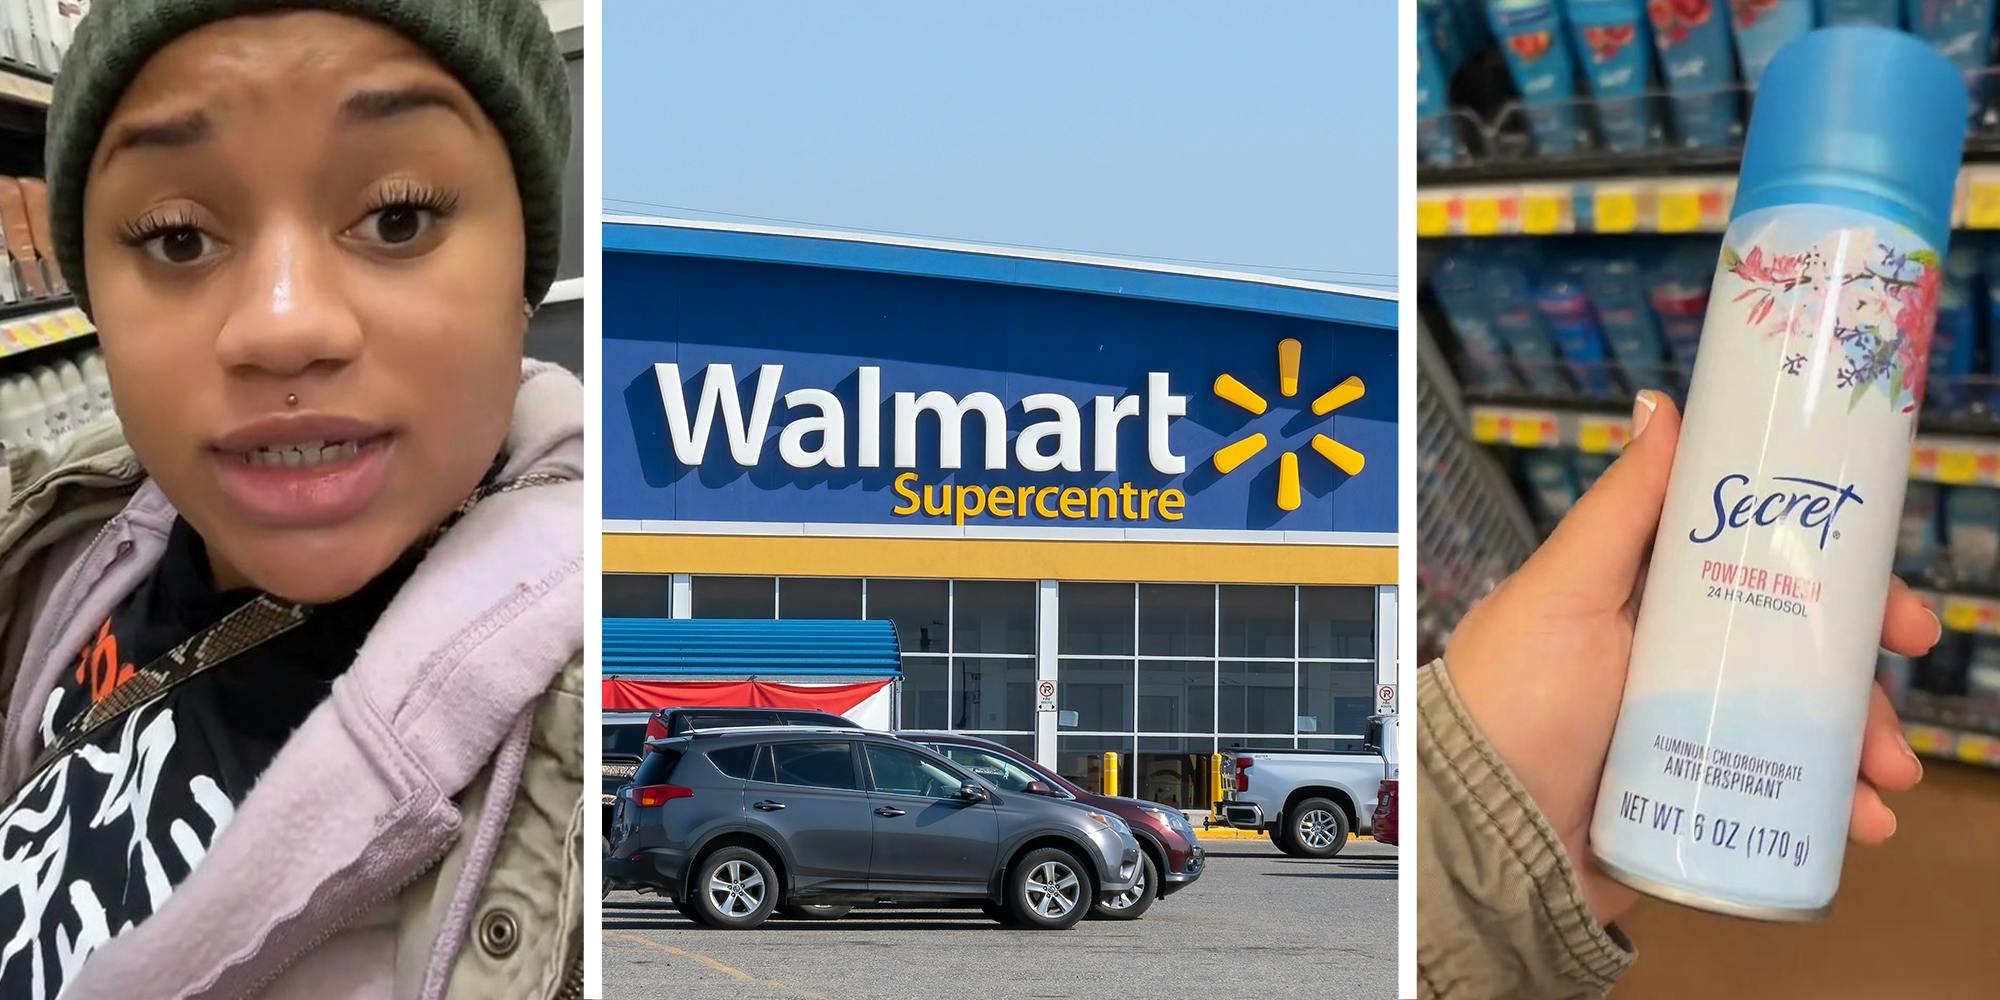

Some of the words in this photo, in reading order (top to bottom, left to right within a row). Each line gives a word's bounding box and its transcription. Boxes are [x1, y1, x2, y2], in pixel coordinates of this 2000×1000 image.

[655, 362, 1187, 475] Walmart
[893, 472, 1186, 527] Supercentre
[1689, 473, 1863, 550] Secret
[1701, 560, 1768, 591] POWDER
[1772, 573, 1822, 604] FREH
[1707, 586, 1722, 600] 24
[1724, 588, 1743, 602] HR
[1745, 592, 1808, 618] AEROSOL
[1653, 734, 1710, 762] ALUMINUM
[1712, 748, 1804, 782] CHLOROHYDRATE
[1620, 791, 1649, 825] NET
[1691, 814, 1706, 842] 6
[1712, 818, 1740, 850] OZ
[1746, 826, 1789, 859] (170
[1794, 834, 1811, 868] g)
